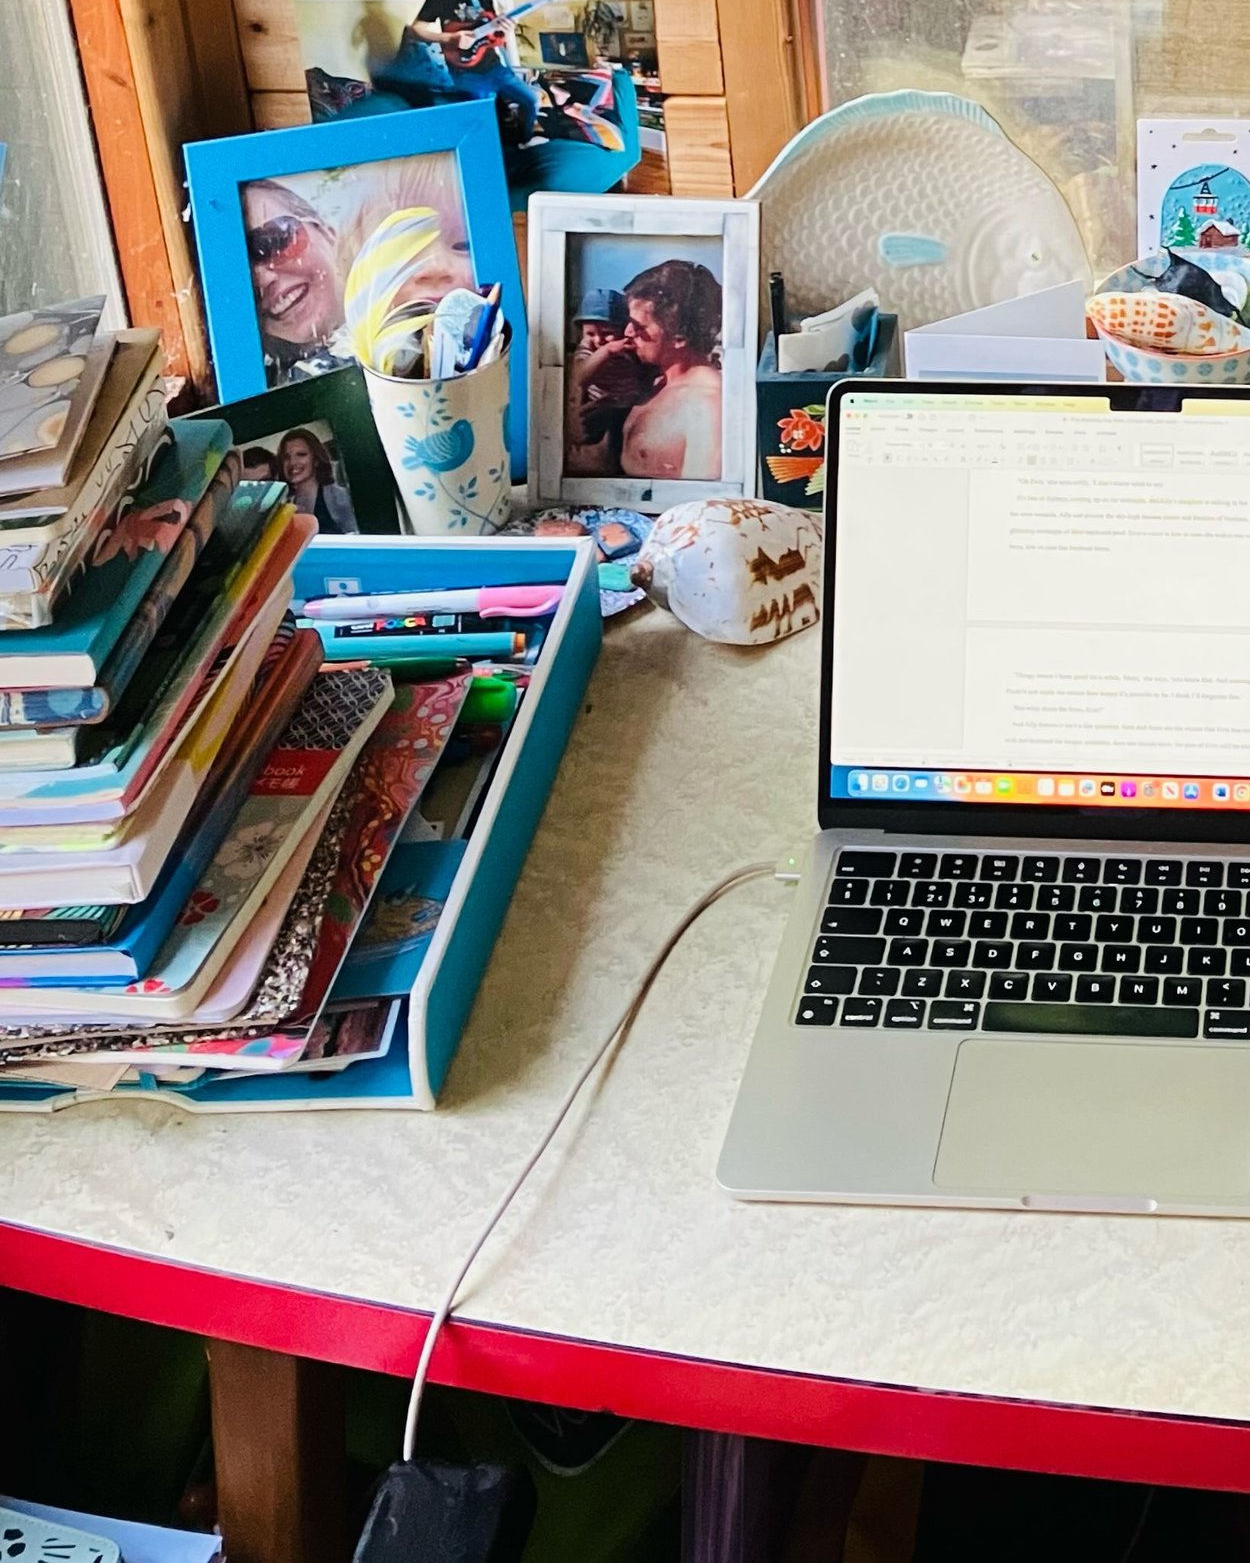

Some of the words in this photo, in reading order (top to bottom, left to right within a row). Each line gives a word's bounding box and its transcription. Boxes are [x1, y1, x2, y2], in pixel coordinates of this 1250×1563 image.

[263, 764, 308, 776] book
[898, 916, 909, 926] Q
[940, 918, 953, 927] W
[983, 919, 992, 929] E
[1025, 920, 1035, 930] R
[1068, 921, 1077, 931] T
[1110, 923, 1119, 932] Y
[1151, 924, 1162, 934] U
[1196, 926, 1201, 935] I
[1236, 927, 1247, 936] O
[902, 946, 912, 956] A
[945, 947, 955, 957] S
[987, 949, 998, 958] D
[1031, 950, 1040, 959] F
[1073, 951, 1083, 961] G
[1116, 953, 1126, 962] H
[1159, 954, 1168, 964] J
[1202, 956, 1211, 965] K
[917, 976, 927, 987] Z
[960, 978, 971, 988] X
[1003, 979, 1014, 990] C
[1047, 981, 1057, 991] V
[1090, 982, 1100, 993] B
[1133, 984, 1144, 994] N
[1176, 985, 1188, 995] M
